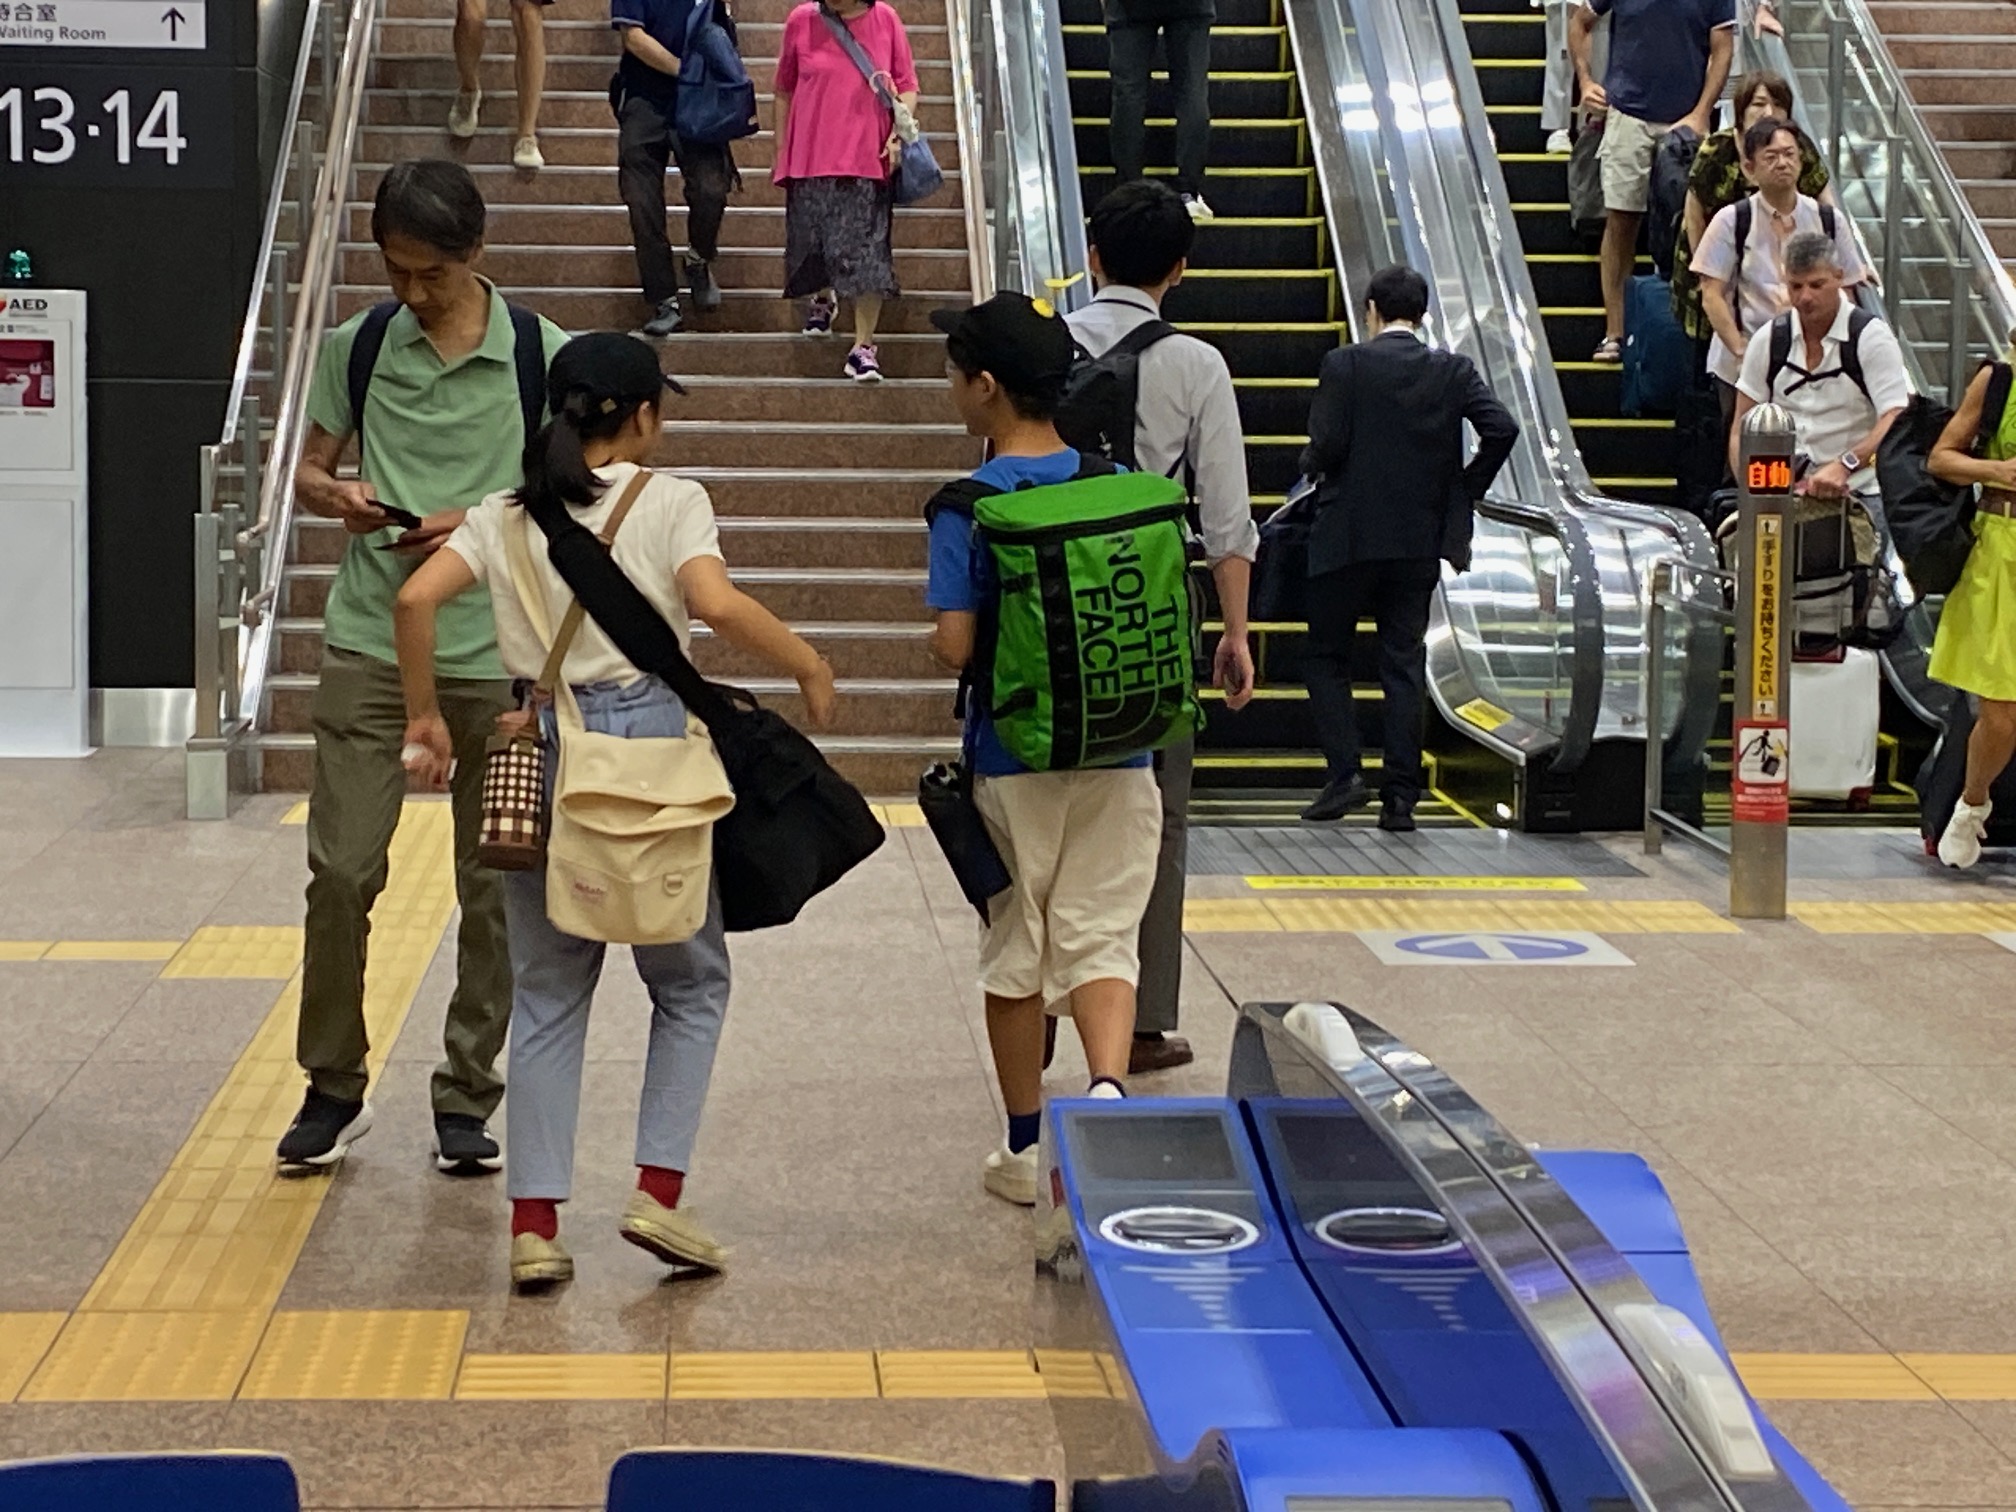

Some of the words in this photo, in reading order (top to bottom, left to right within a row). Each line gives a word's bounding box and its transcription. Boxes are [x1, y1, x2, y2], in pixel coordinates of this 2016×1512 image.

[59, 26, 106, 40] Room
[9, 298, 48, 311] AED
[1748, 461, 1791, 488] 自動
[1075, 587, 1121, 696] FACE
[1105, 532, 1156, 691] NORTH
[1152, 594, 1184, 687] THE
